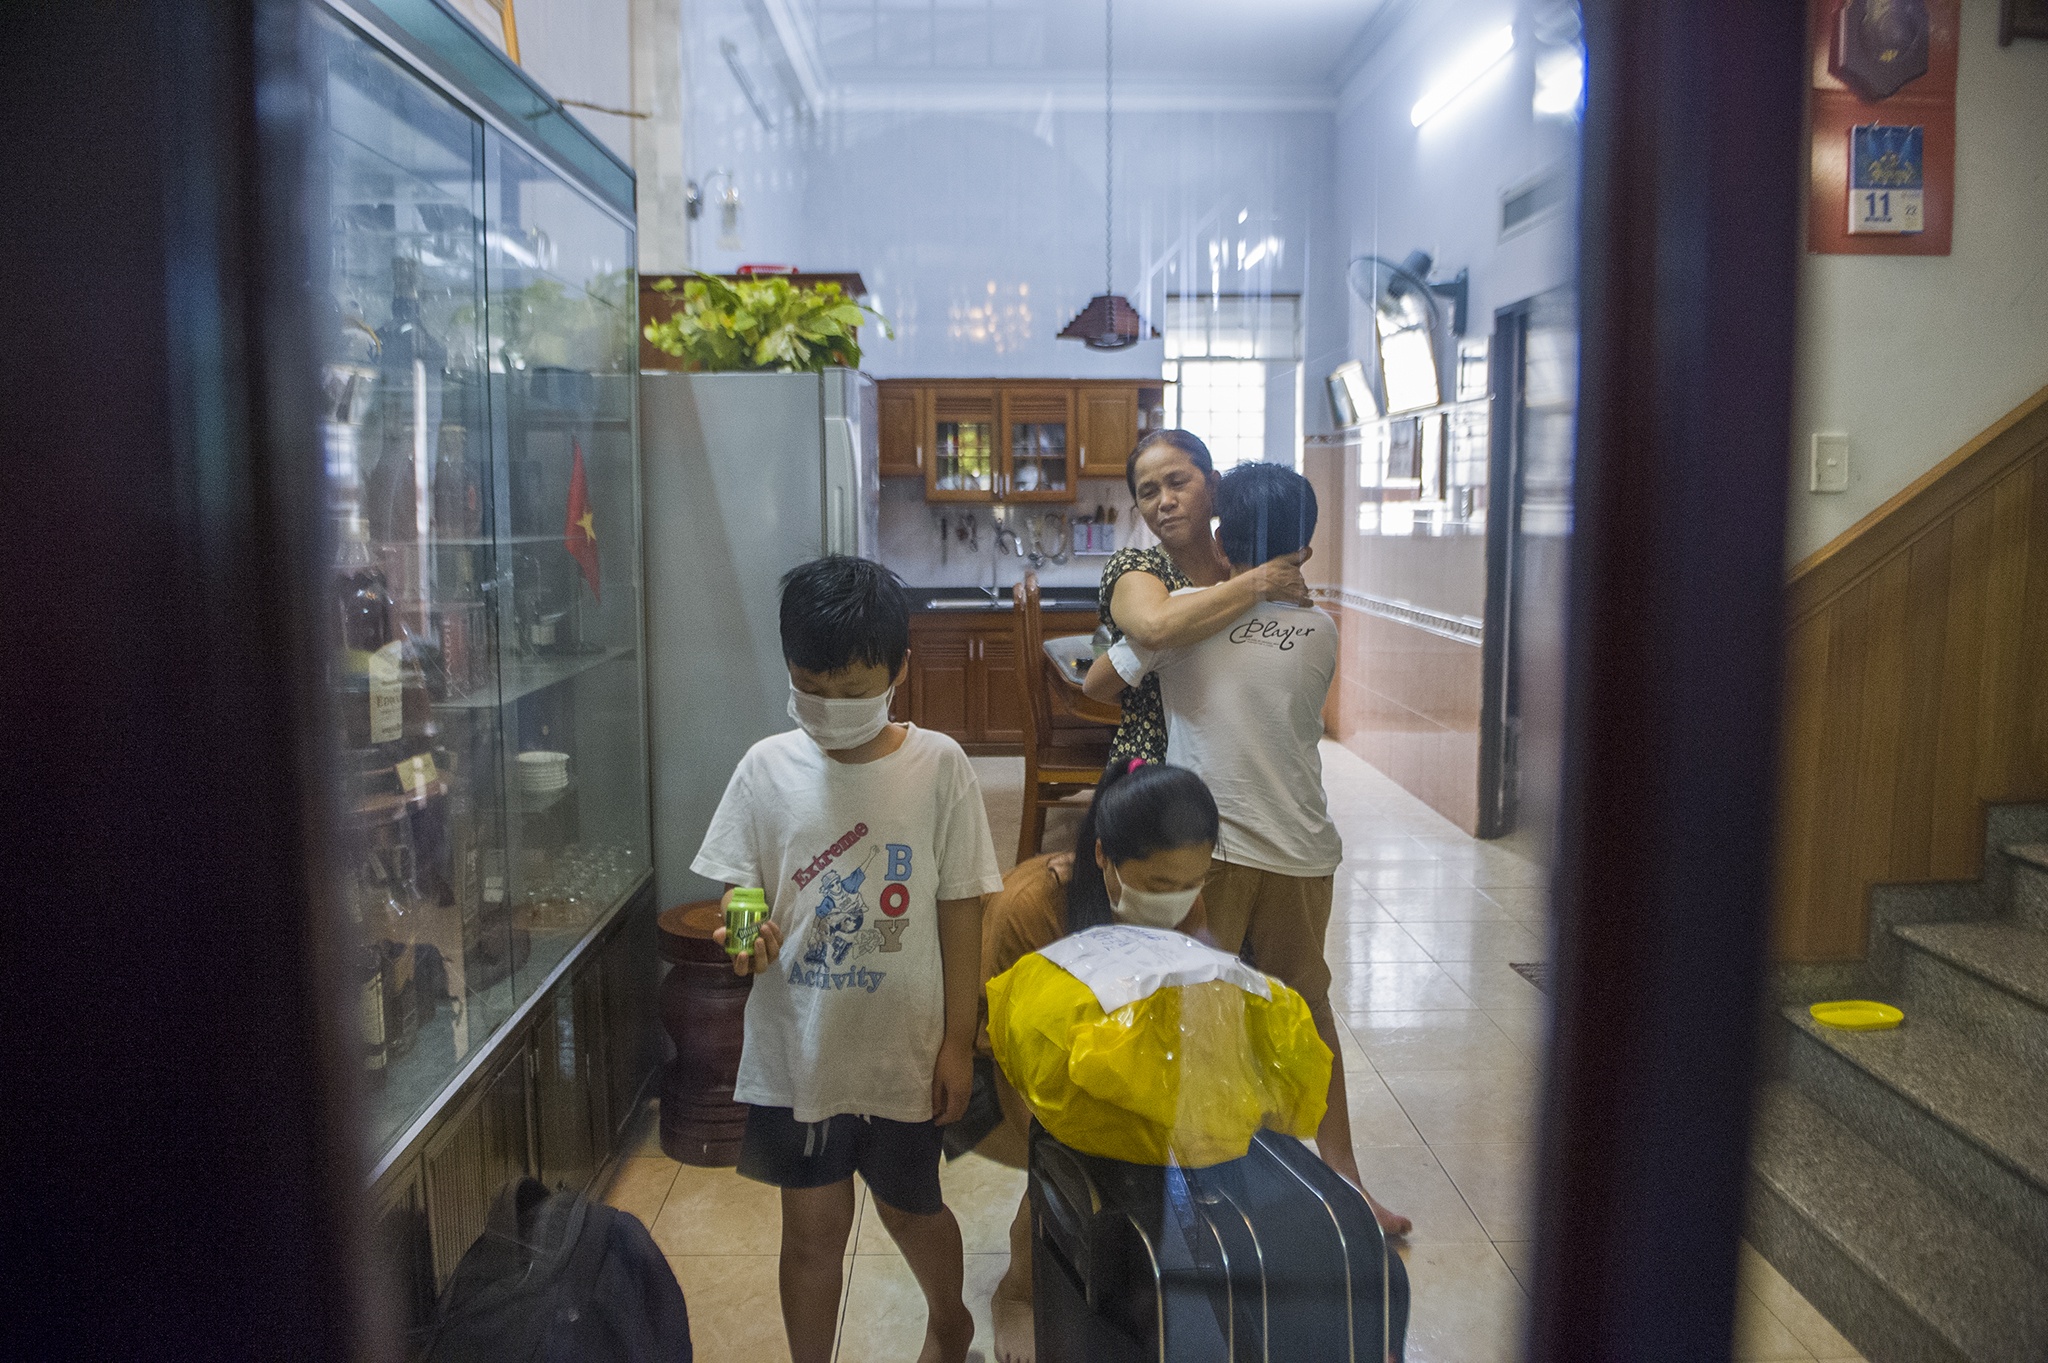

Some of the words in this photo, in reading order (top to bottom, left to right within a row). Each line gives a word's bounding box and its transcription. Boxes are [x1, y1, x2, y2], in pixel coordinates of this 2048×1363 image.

[1865, 192, 1890, 217] 11
[1229, 618, 1315, 651] Player
[791, 822, 869, 891] Extreme
[874, 843, 912, 952] BOY
[788, 961, 886, 993] Activity
